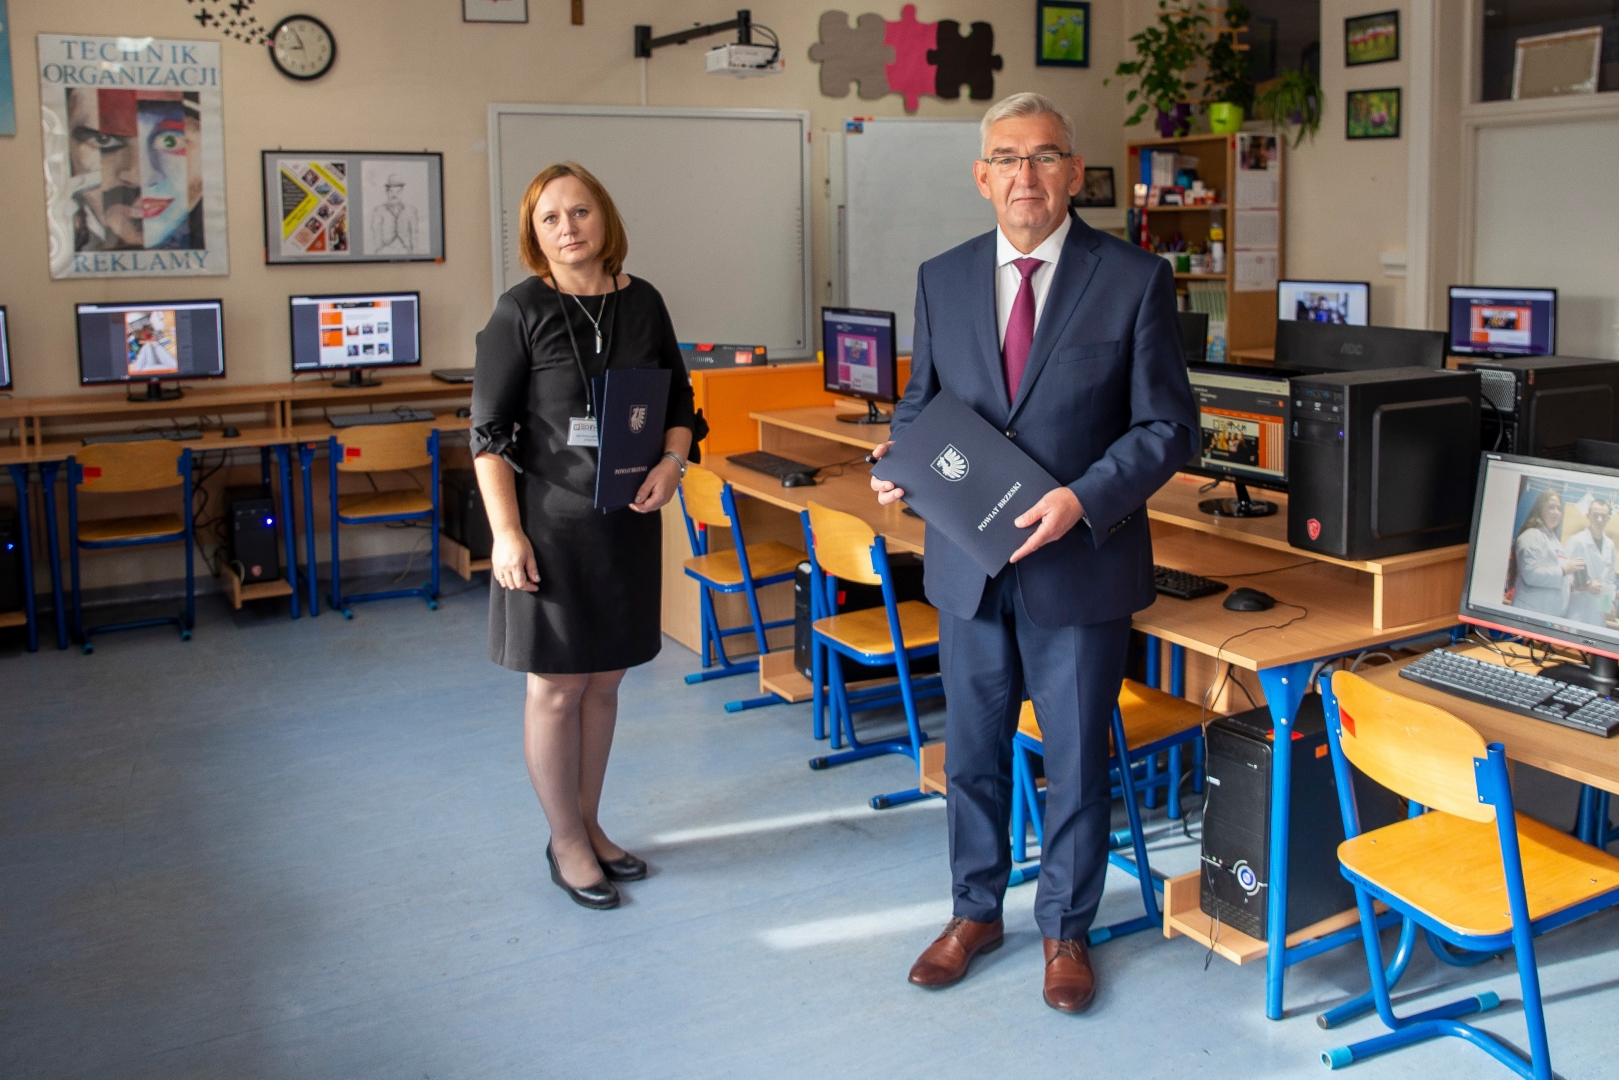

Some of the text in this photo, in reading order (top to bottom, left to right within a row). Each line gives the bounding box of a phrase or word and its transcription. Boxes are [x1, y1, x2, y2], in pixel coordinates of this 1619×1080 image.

[60, 39, 198, 65] TECHNIK
[43, 63, 217, 87] ORGANIZACJI
[74, 251, 209, 273] REKLAMY
[977, 481, 1022, 532] POWIAT BRZESKI
